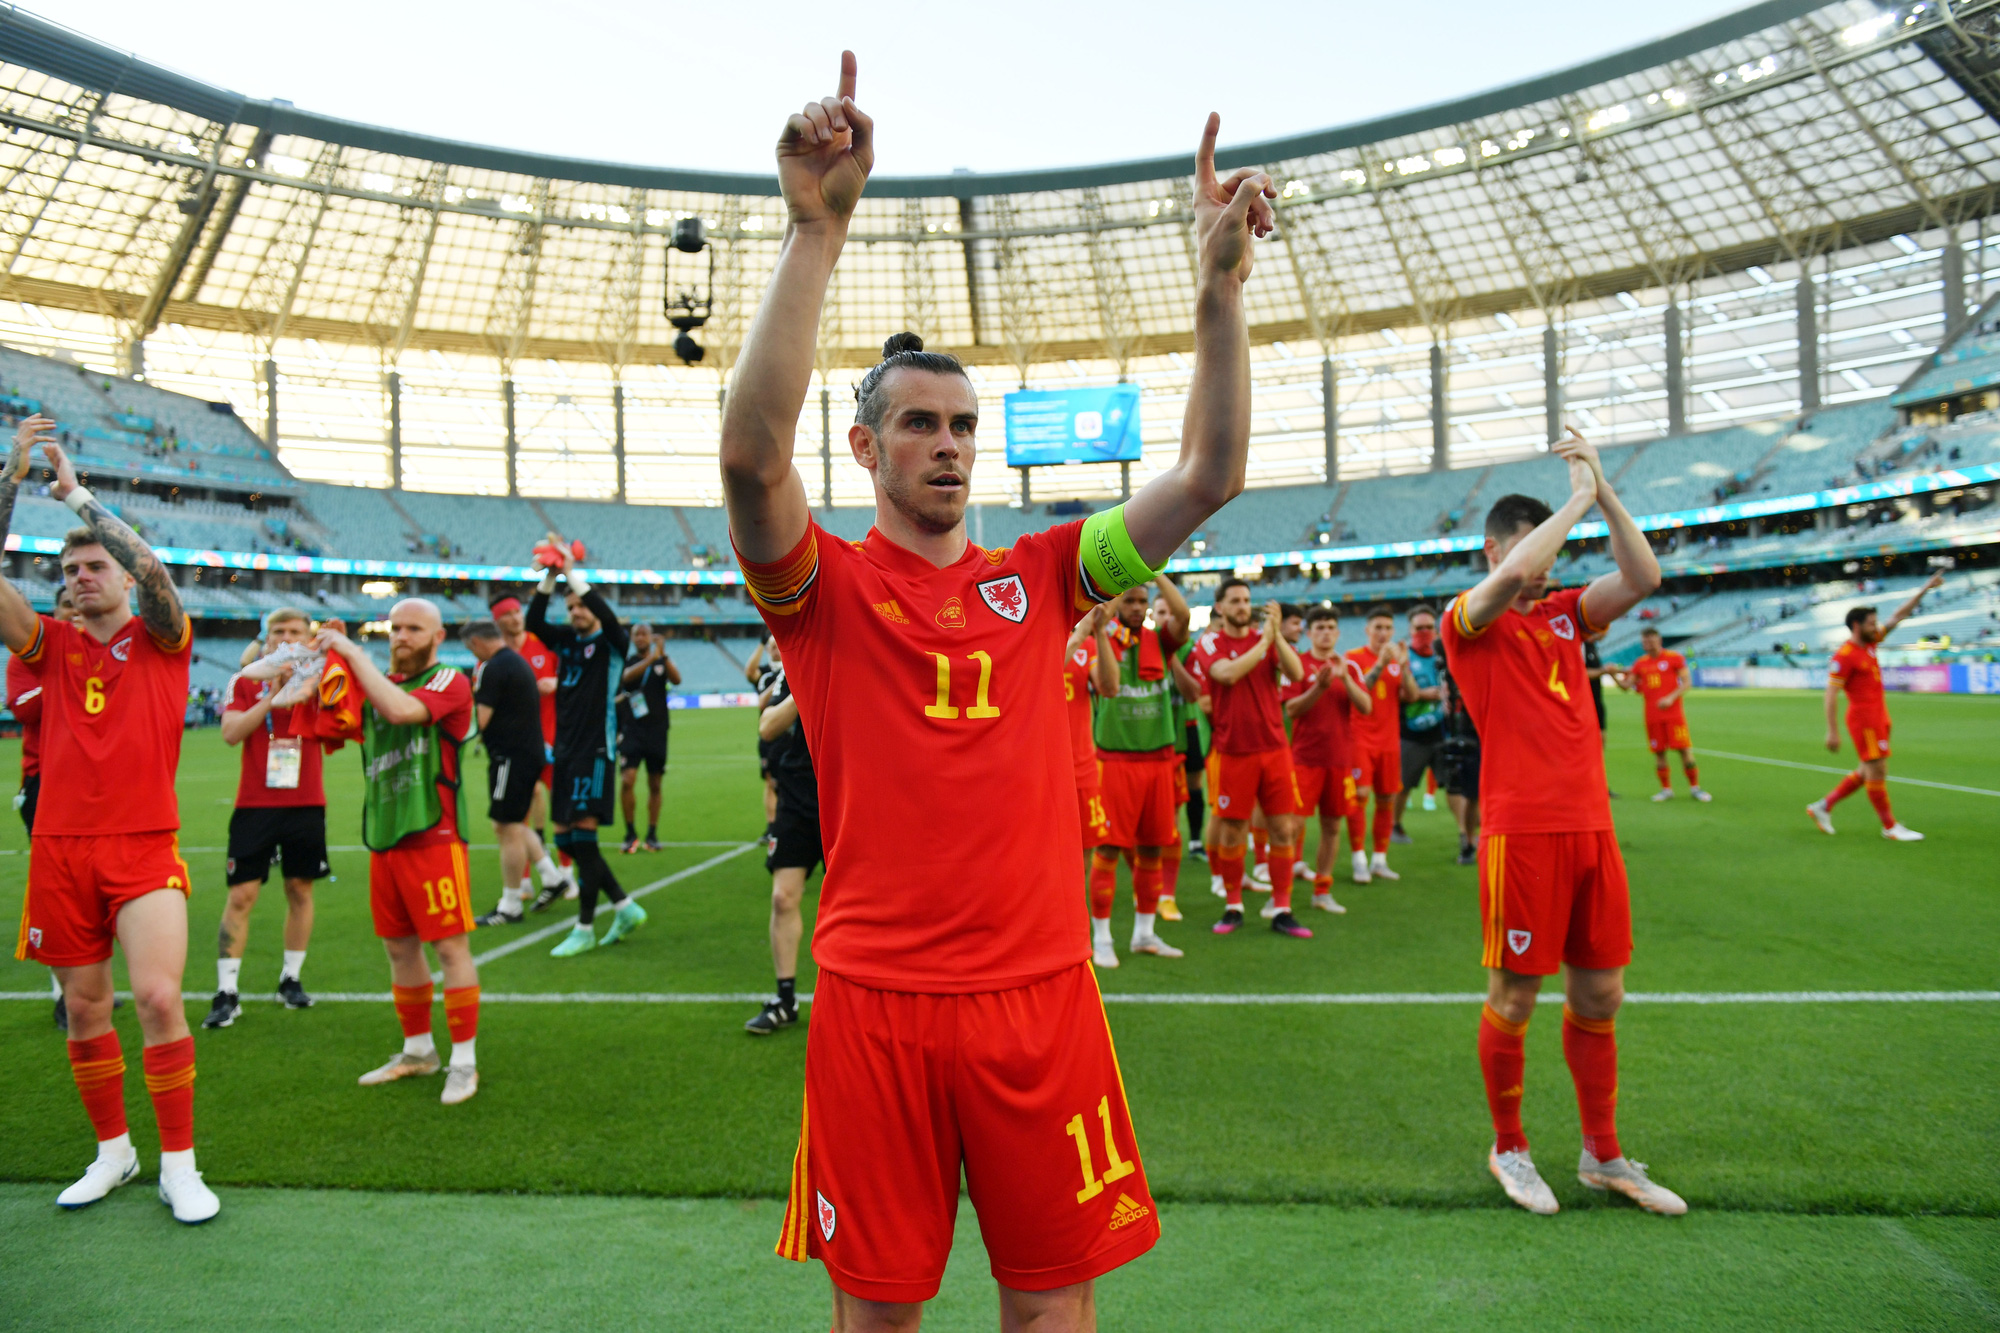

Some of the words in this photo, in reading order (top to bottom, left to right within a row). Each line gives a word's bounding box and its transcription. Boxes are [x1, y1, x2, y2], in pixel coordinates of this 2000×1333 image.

[1097, 527, 1123, 578] RESPECT
[872, 603, 910, 625] adidas
[84, 676, 106, 715] 6
[925, 650, 1001, 719] 11
[1548, 660, 1571, 702] 4
[571, 776, 593, 801] 12
[422, 876, 458, 916] 18
[1066, 1095, 1136, 1205] 11
[1108, 1205, 1150, 1231] adidas
